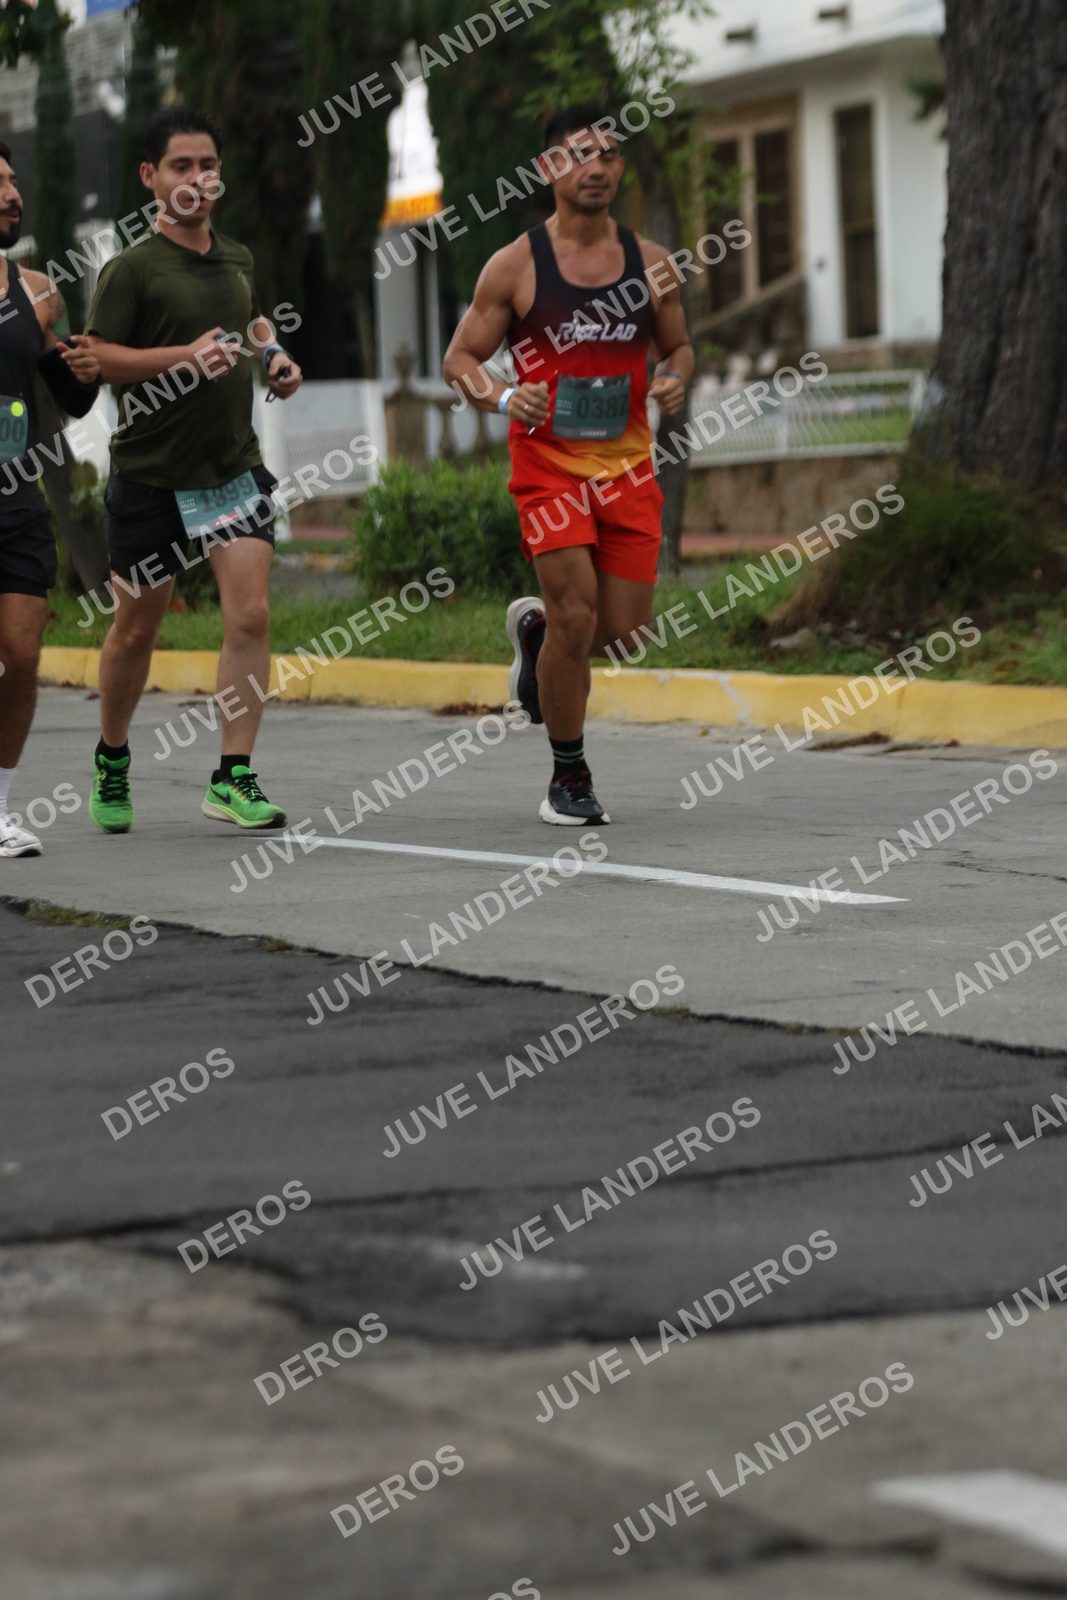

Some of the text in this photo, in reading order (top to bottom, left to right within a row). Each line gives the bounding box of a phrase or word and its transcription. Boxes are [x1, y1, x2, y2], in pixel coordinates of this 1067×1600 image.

[600, 322, 638, 342] LAB
[576, 392, 629, 420] 0387
[200, 476, 254, 513] 1899
